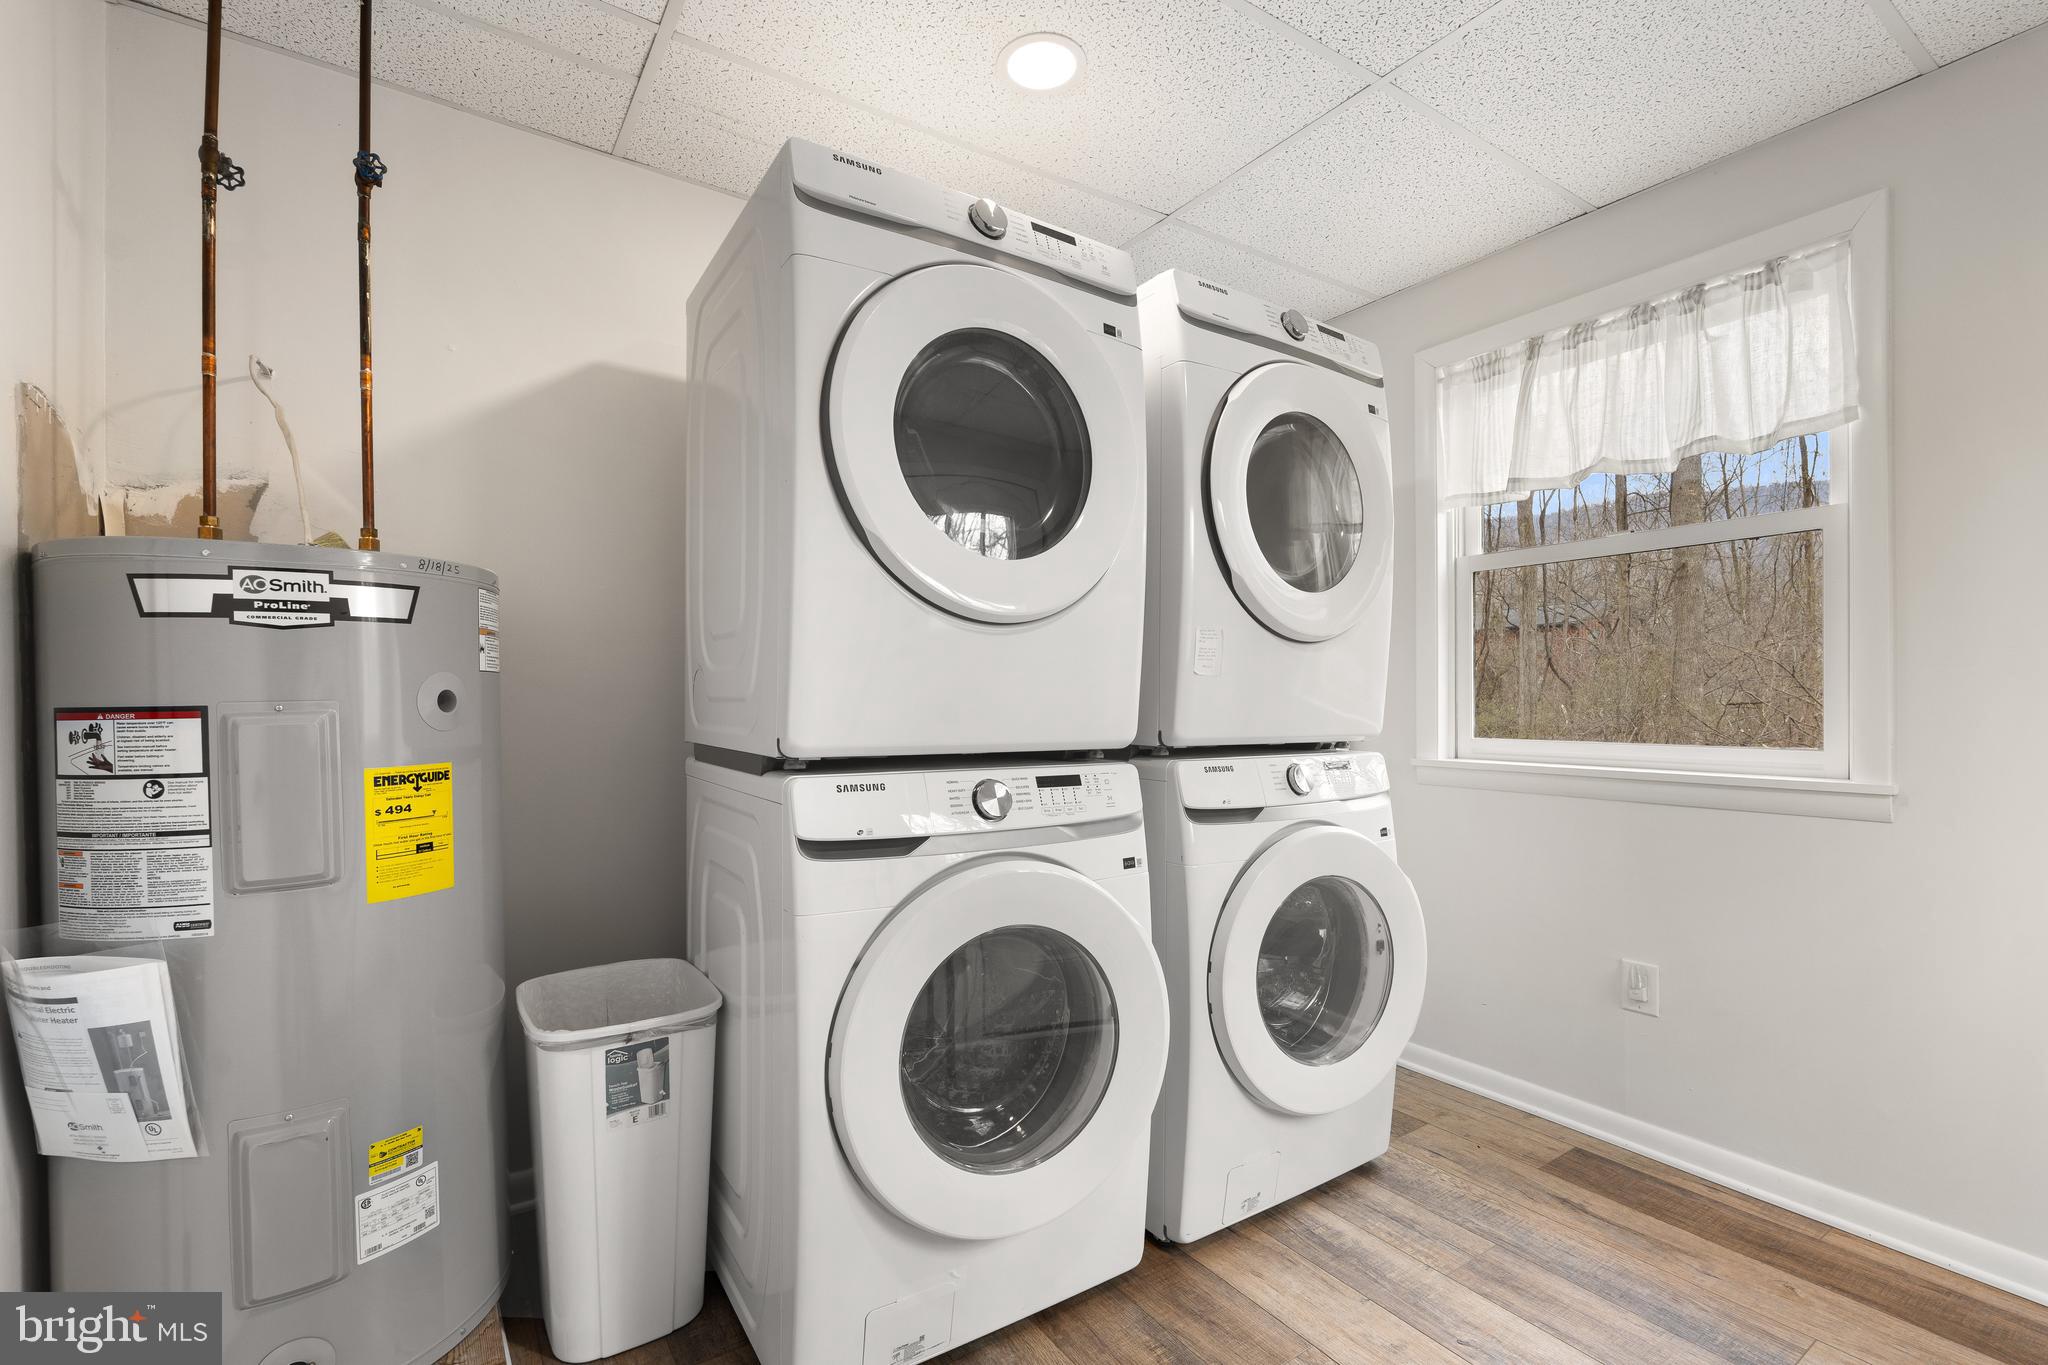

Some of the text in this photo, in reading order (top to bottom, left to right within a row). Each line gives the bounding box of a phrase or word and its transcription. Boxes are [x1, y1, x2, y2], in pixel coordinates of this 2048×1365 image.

[832, 153, 882, 175] SAMSUNG
[1198, 280, 1228, 295] SAMSUNG
[836, 782, 886, 793] SAMSUNG
[385, 804, 412, 815] 494
[45, 1006, 76, 1014] Electric
[50, 1017, 79, 1025] Heater
[607, 1056, 629, 1065] logic
